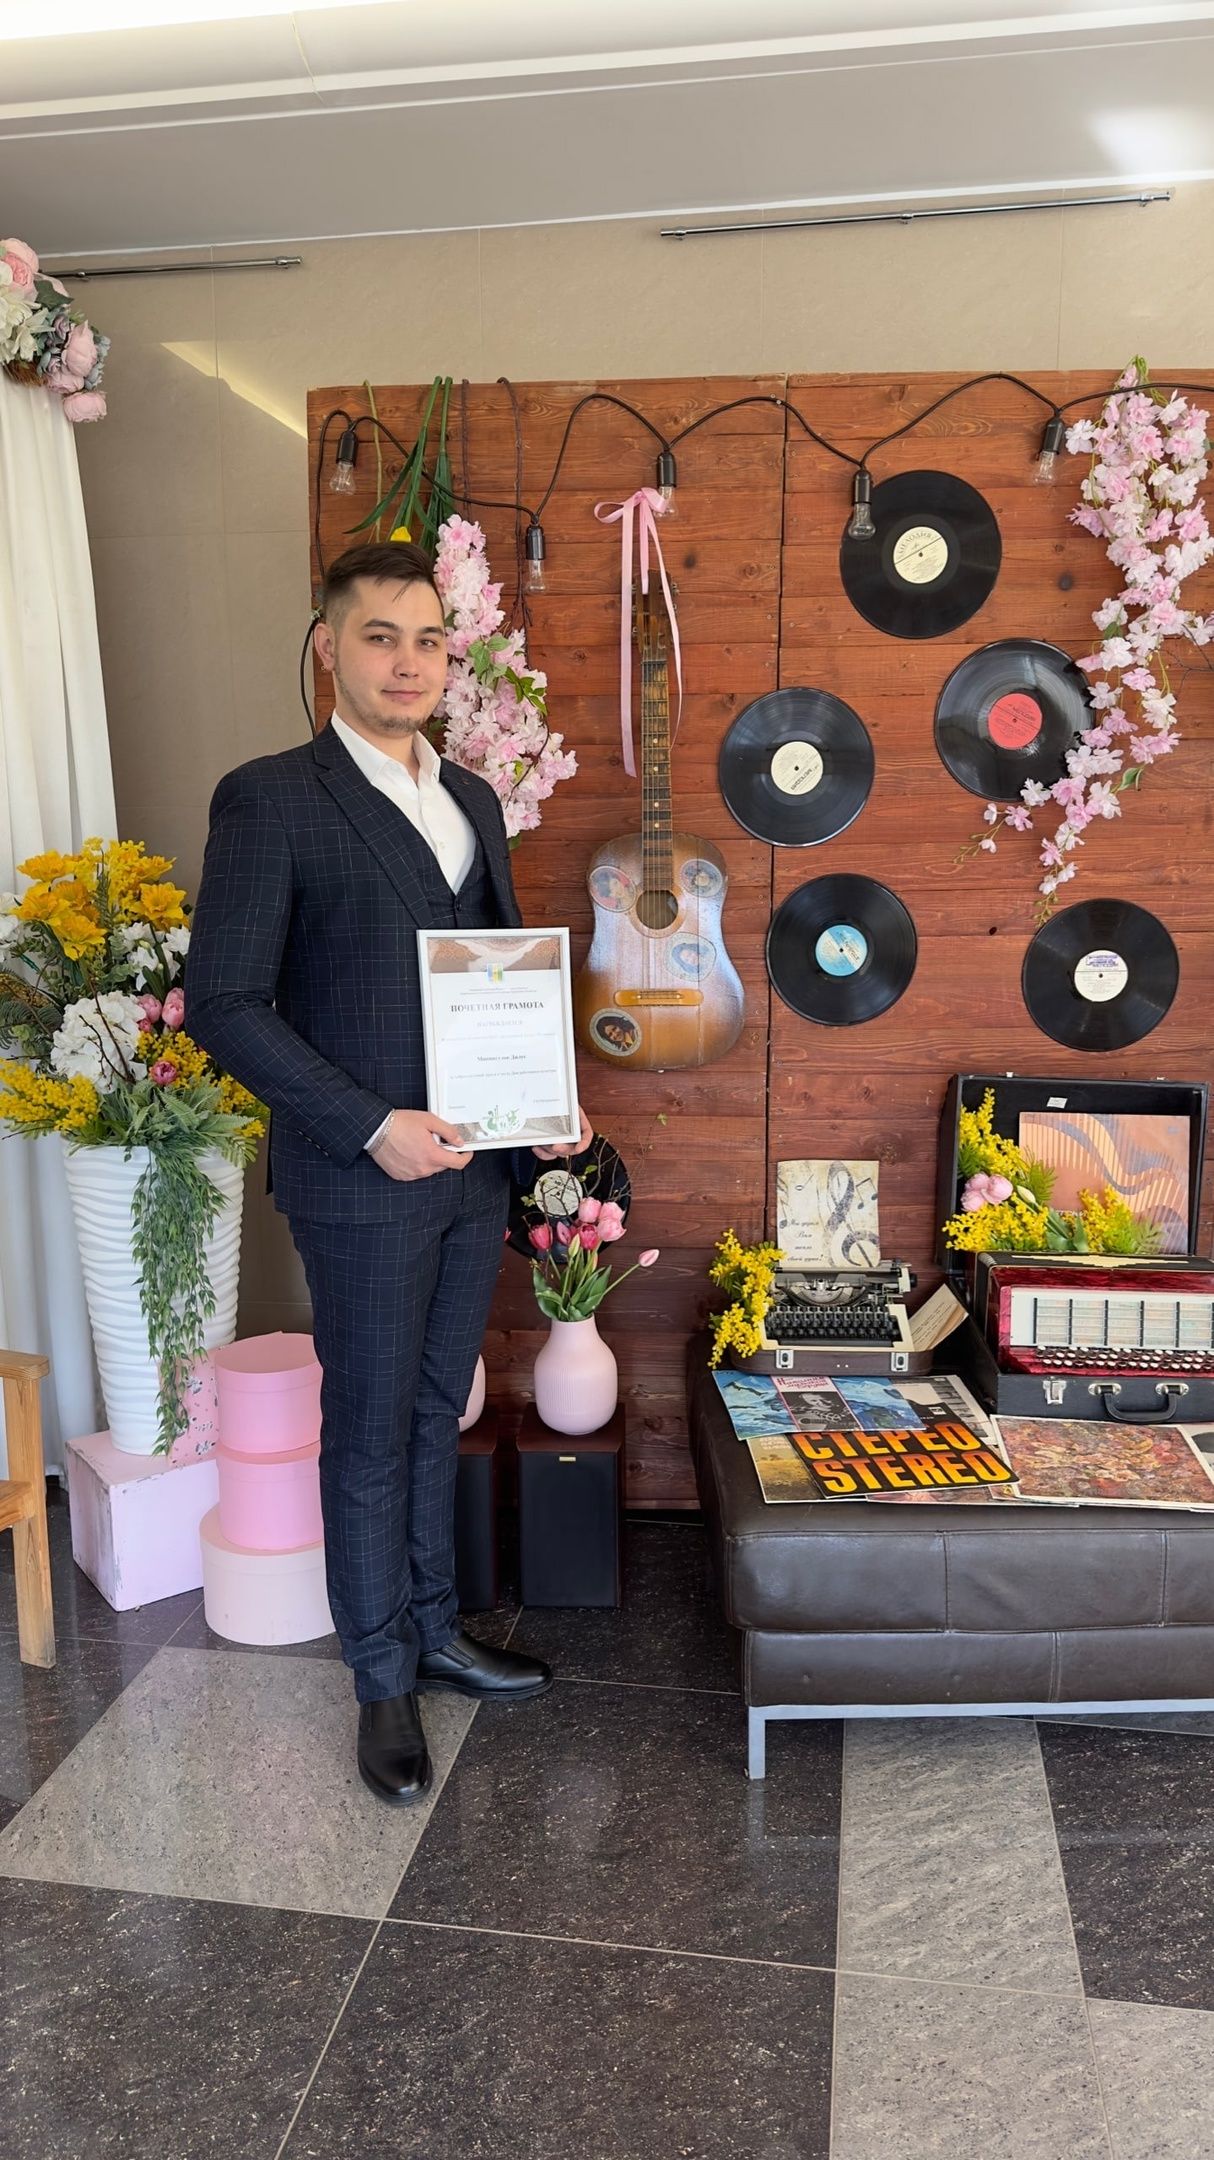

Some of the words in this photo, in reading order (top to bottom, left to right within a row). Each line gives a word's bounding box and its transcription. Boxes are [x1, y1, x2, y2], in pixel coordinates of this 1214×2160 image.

[450, 1003, 501, 1013] ПОЧЕТНАЯ
[503, 1001, 544, 1011] ГРАМОТА
[792, 1421, 982, 1460] СТЕРЕО
[812, 1451, 1012, 1493] STEREO
